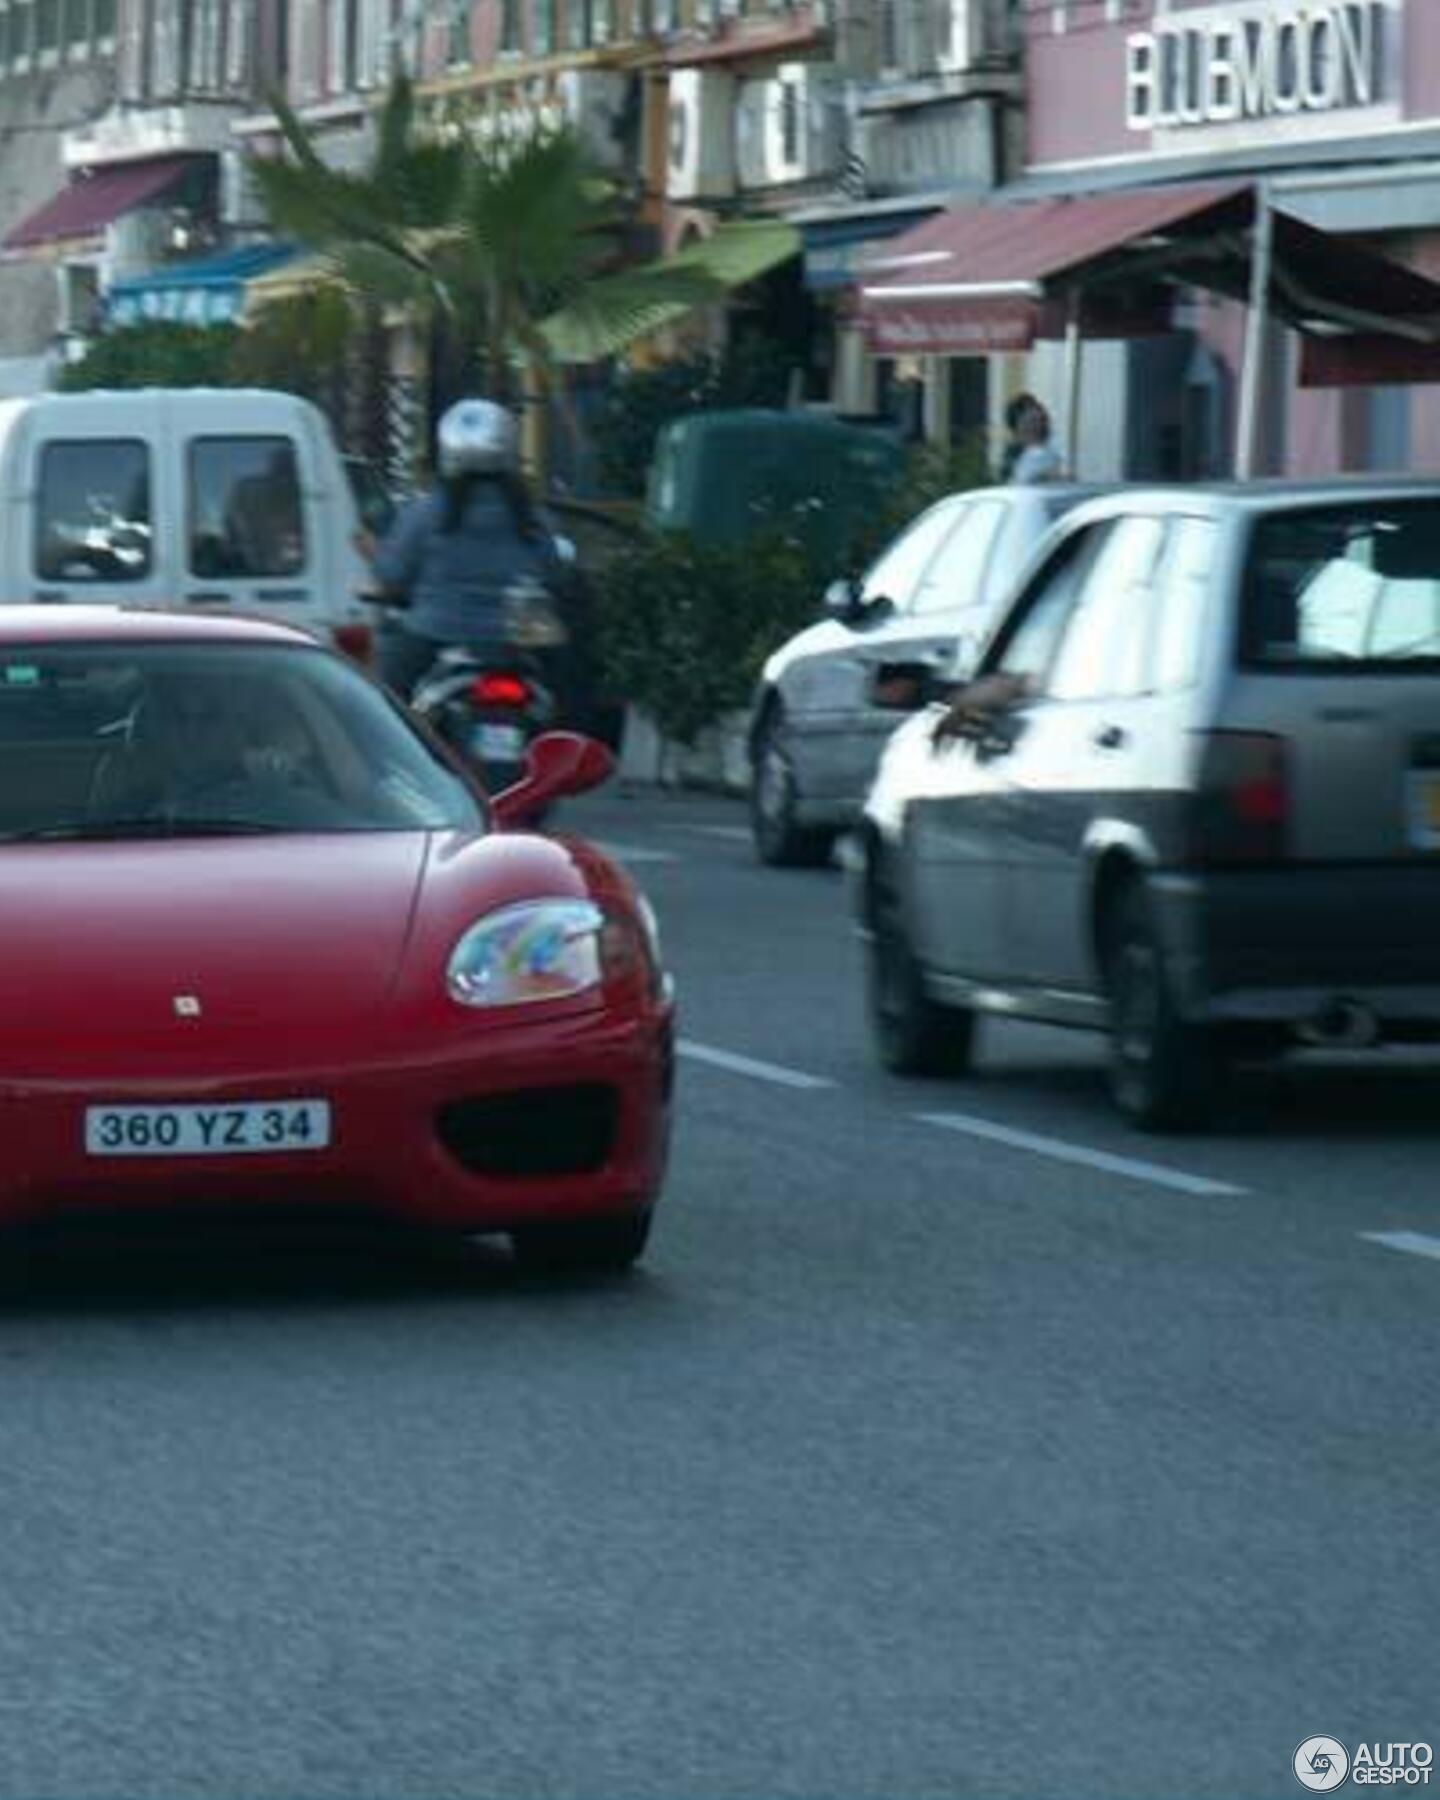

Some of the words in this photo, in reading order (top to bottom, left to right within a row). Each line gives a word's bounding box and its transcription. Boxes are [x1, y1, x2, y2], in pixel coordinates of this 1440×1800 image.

[100, 1113, 178, 1146] 360
[196, 1111, 248, 1145] YZ
[262, 1108, 310, 1142] 34
